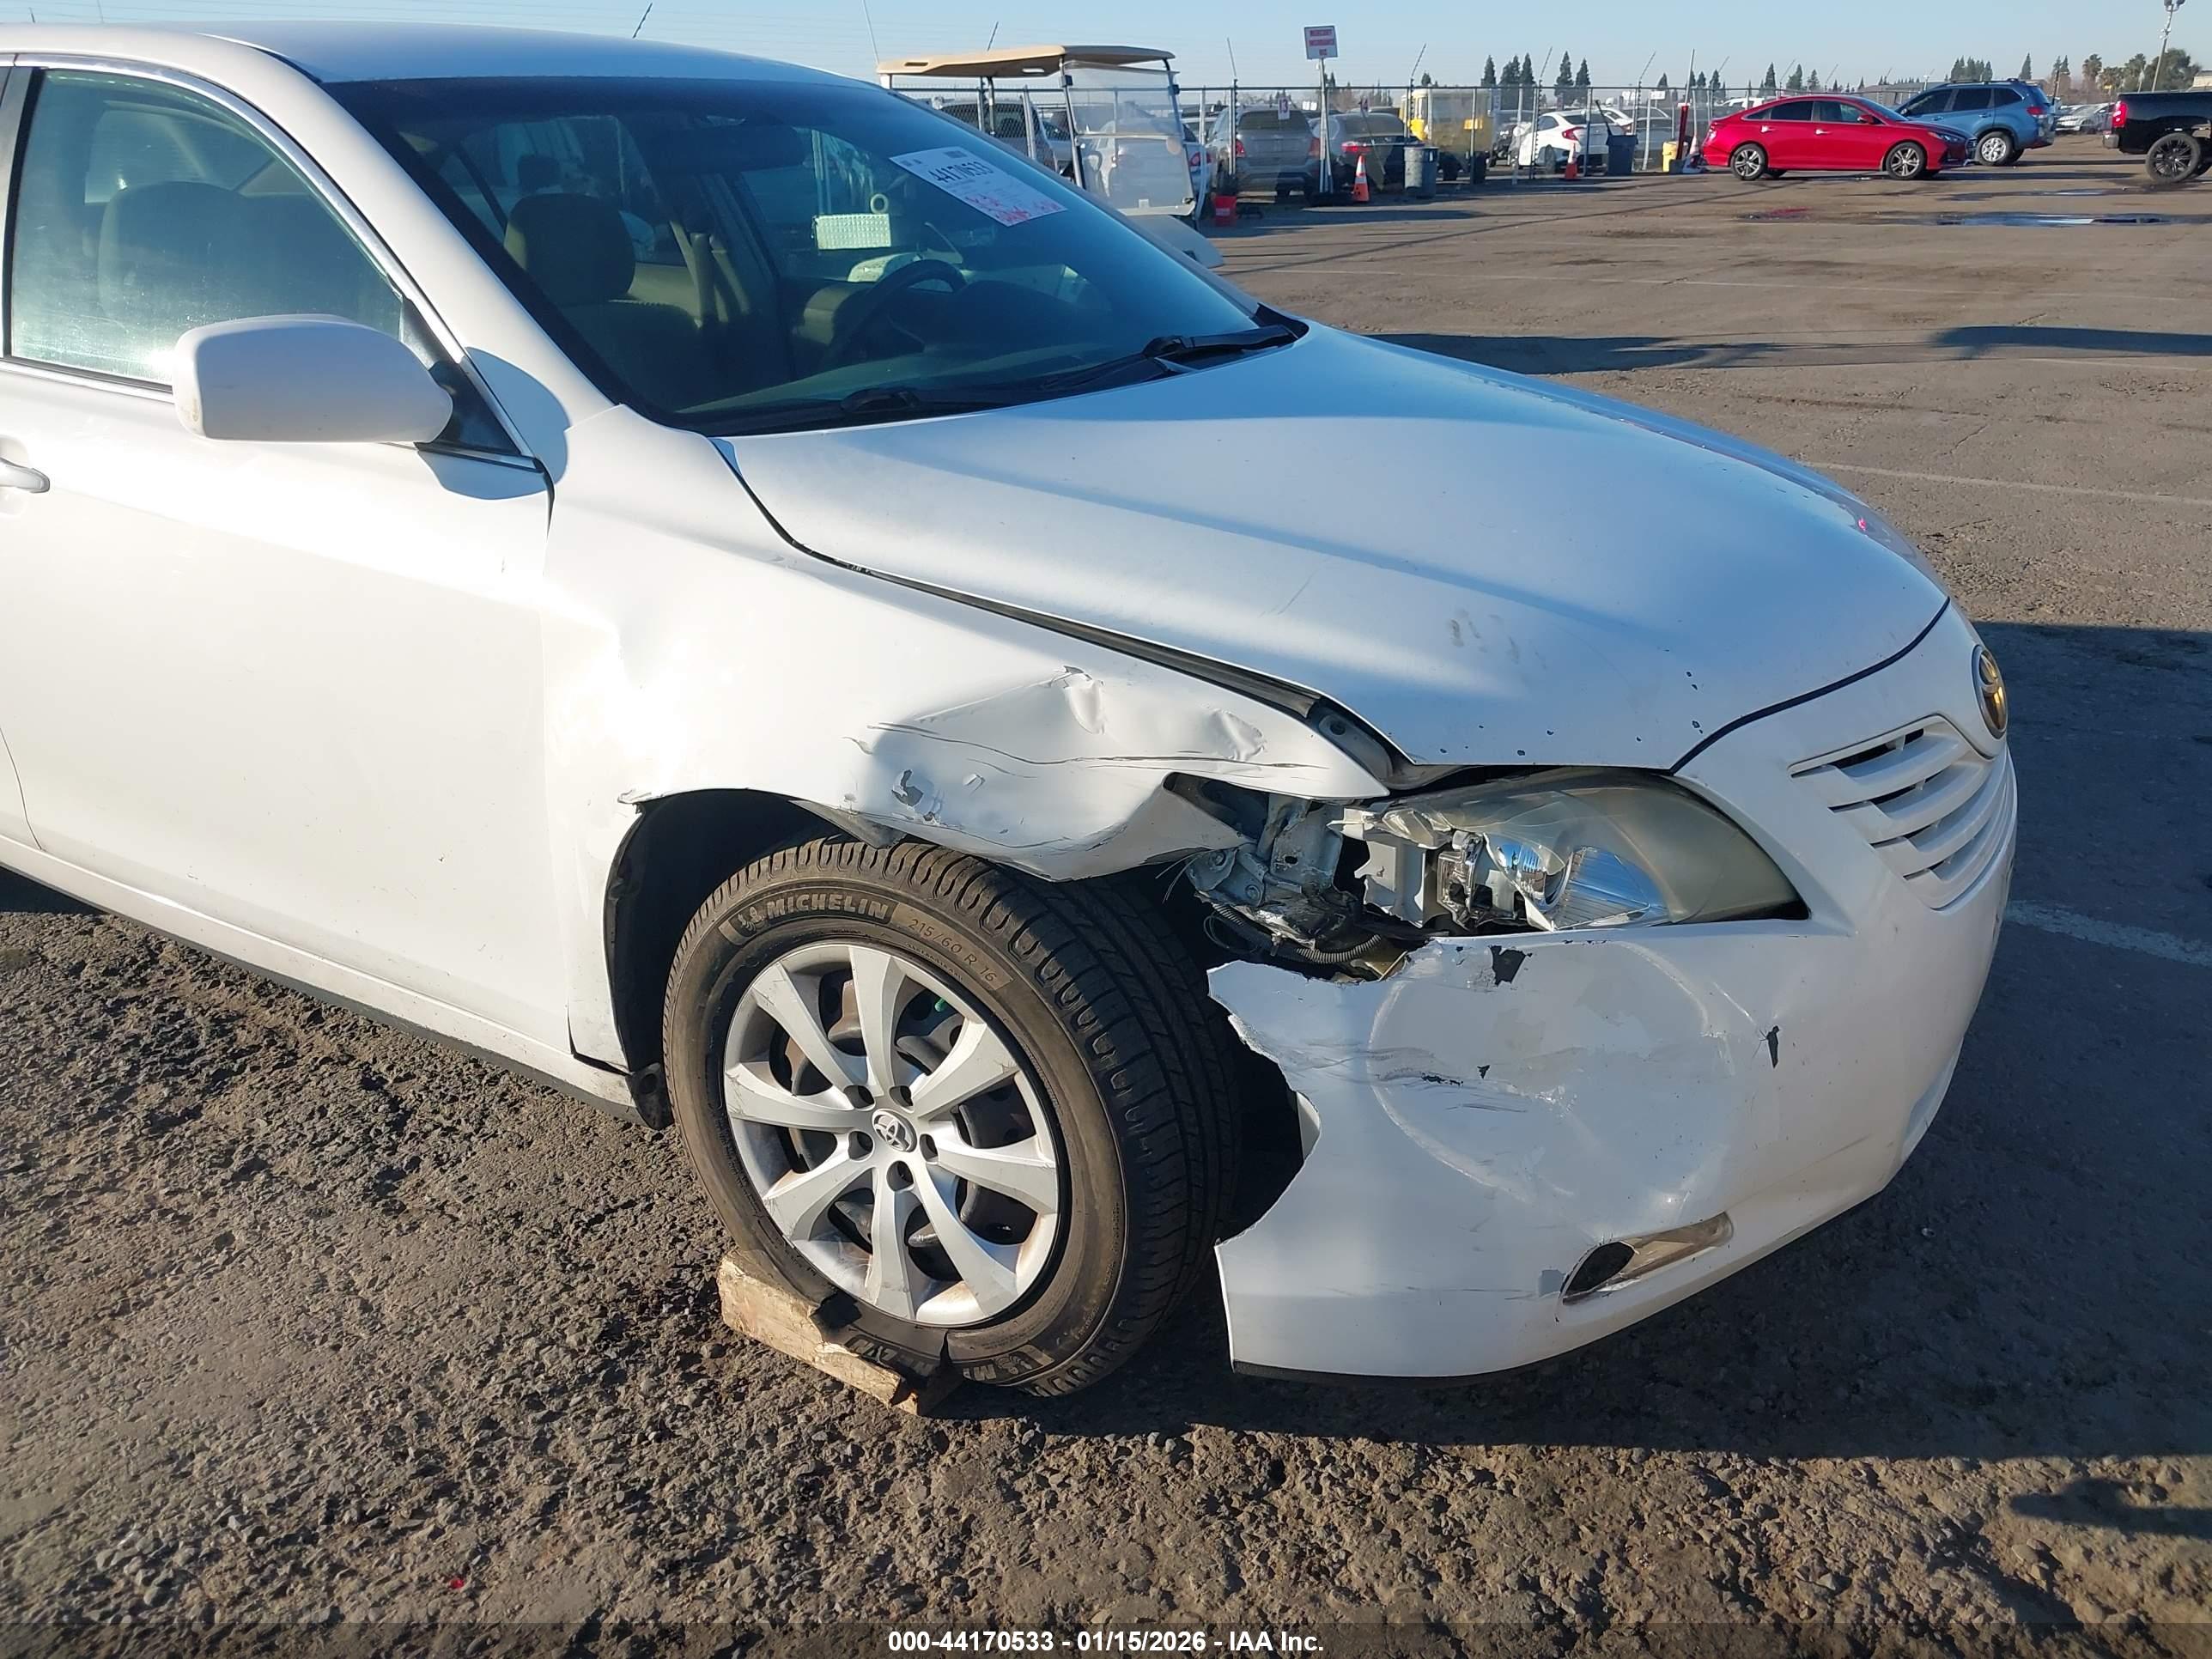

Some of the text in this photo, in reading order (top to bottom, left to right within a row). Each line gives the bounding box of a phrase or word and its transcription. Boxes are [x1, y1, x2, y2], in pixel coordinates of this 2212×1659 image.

[767, 894, 889, 920] MICHELIN
[908, 918, 963, 954] 215/60
[964, 953, 978, 966] R
[980, 965, 998, 982] 16
